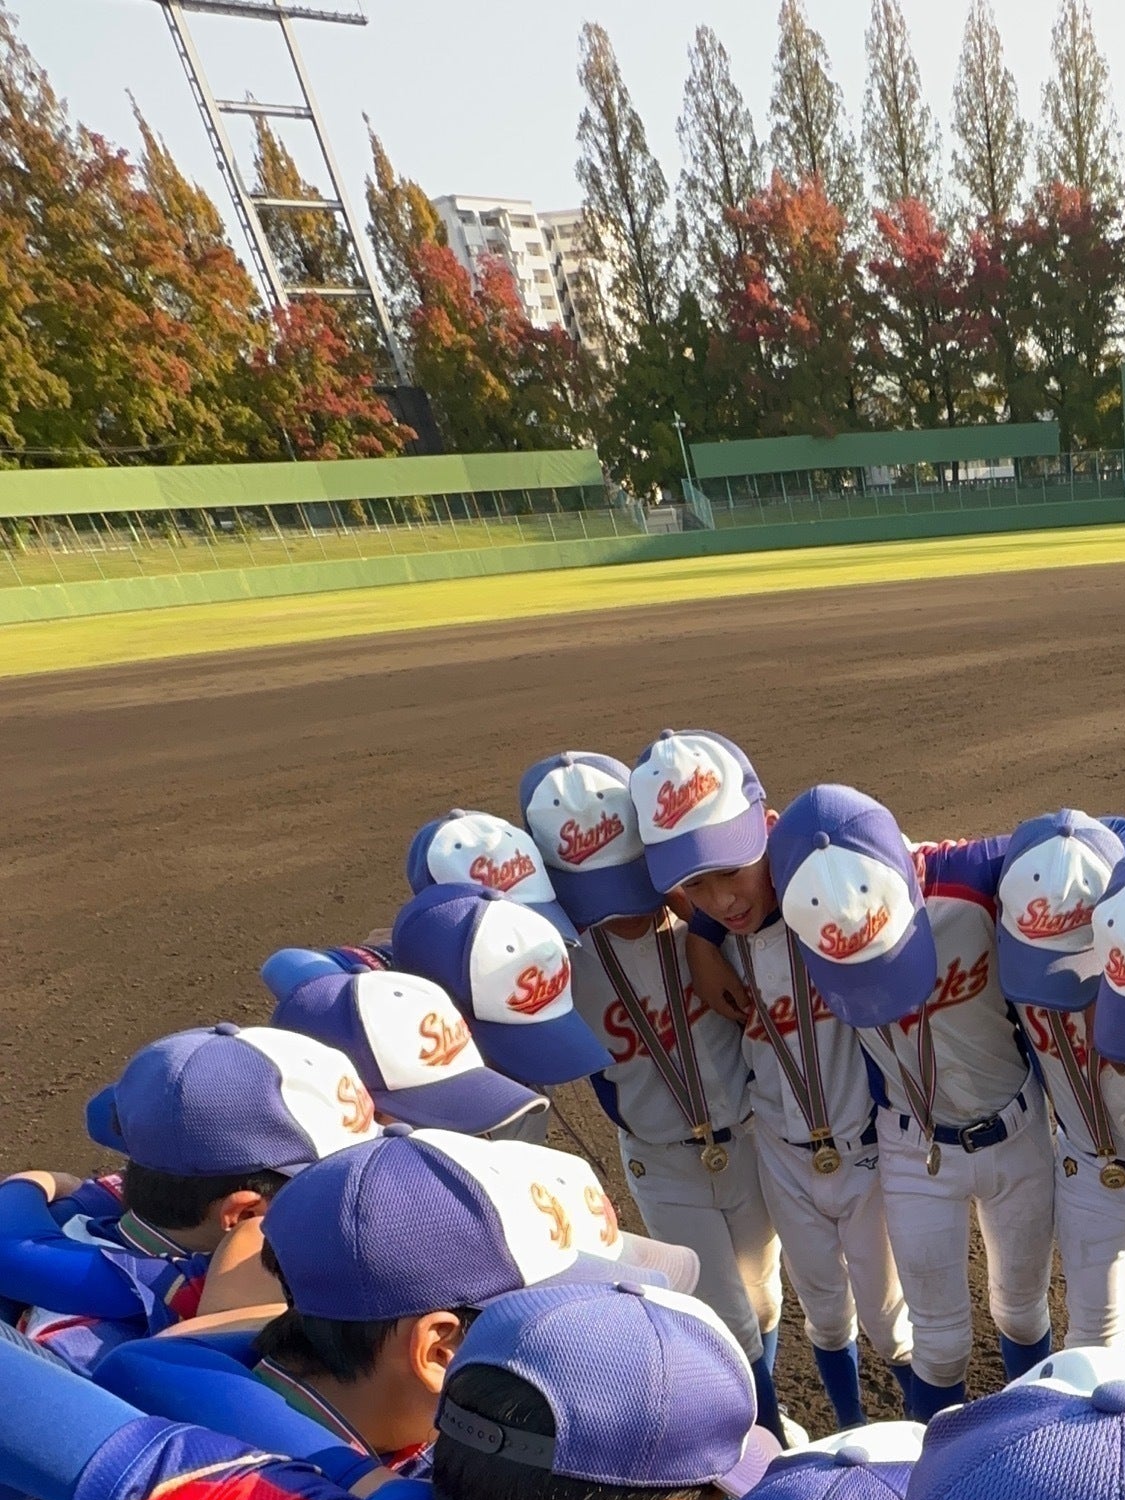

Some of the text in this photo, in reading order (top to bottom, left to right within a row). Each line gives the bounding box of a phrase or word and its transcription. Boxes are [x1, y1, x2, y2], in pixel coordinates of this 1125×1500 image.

[652, 765, 721, 829] Sharks
[557, 811, 624, 865] Sharks
[469, 848, 537, 892] Sharks
[818, 904, 890, 960] Sharks
